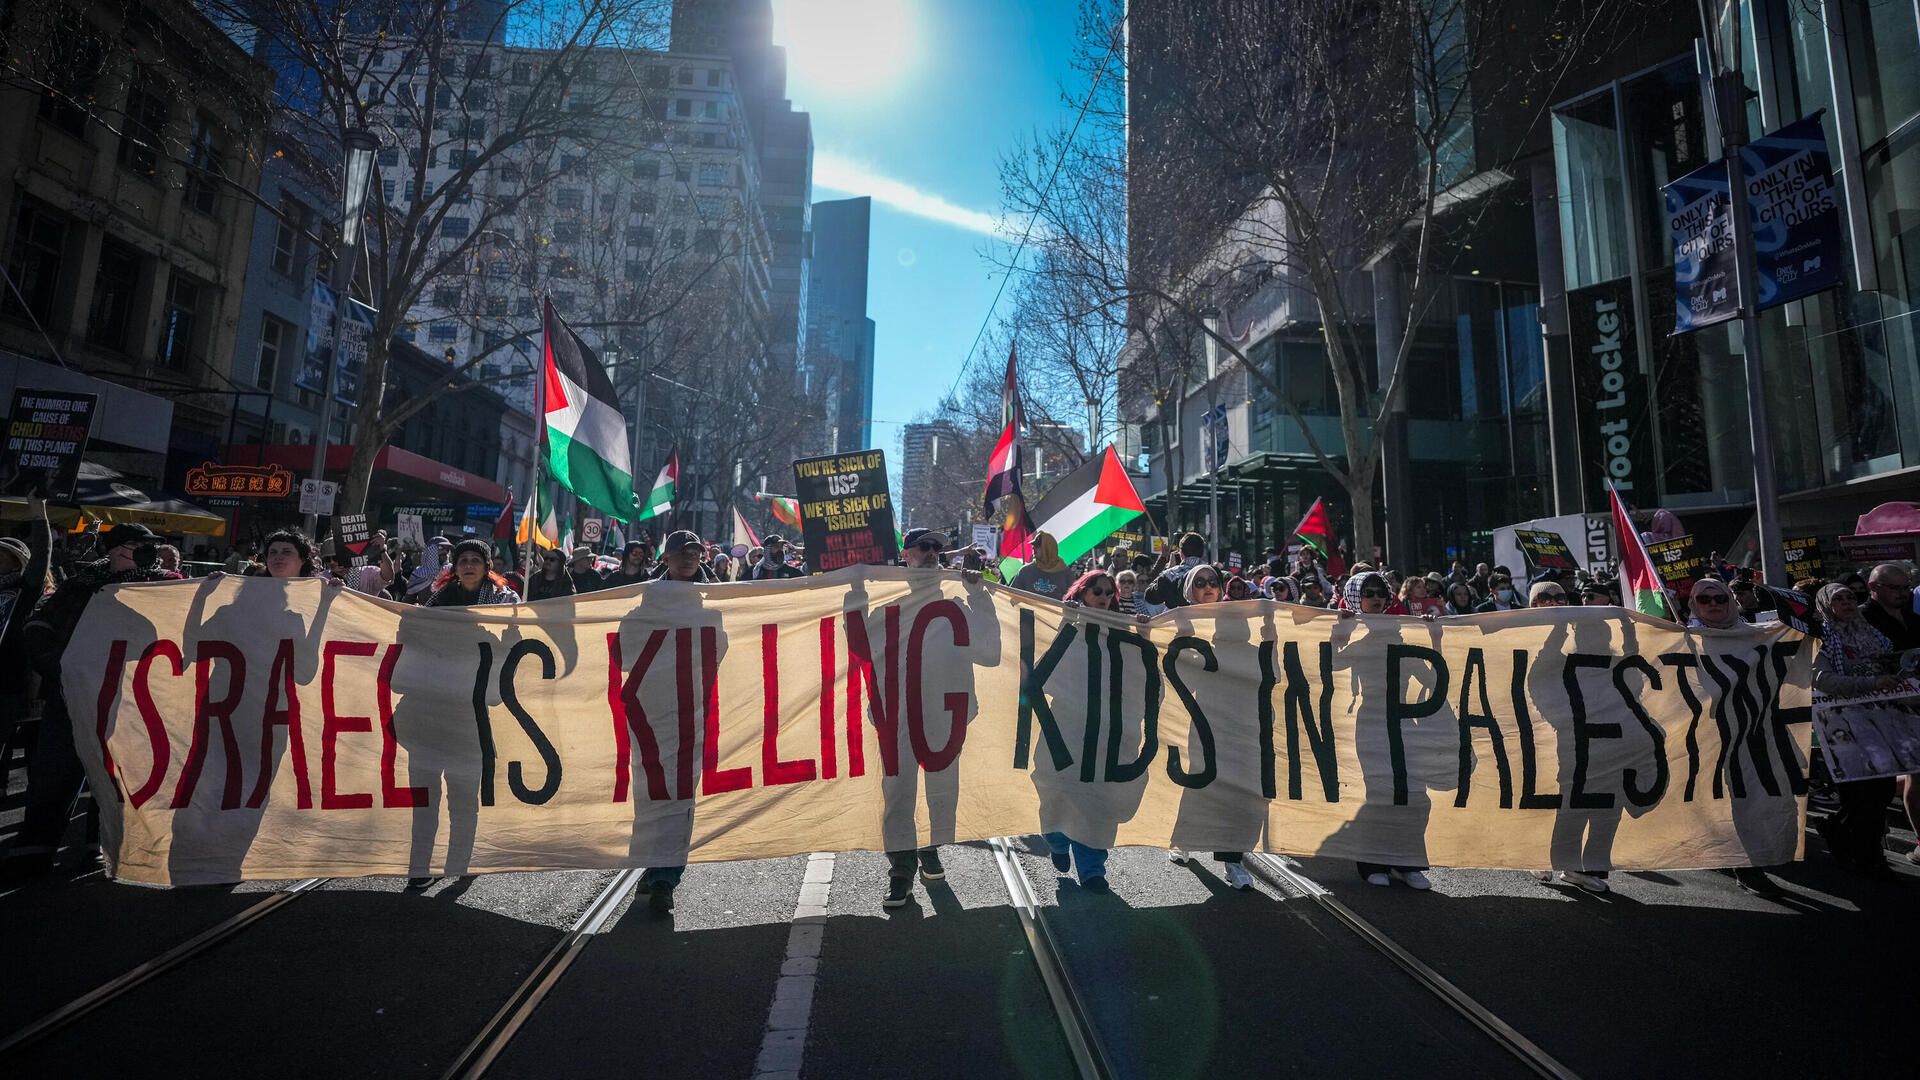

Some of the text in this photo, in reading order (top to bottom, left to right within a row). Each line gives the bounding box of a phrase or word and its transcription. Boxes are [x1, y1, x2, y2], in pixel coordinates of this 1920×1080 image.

[1749, 153, 1816, 196] ONLY IN
[1765, 175, 1805, 204] THIS
[1671, 193, 1721, 231] ONLY IN
[1760, 182, 1825, 223] CITY OF
[1785, 196, 1833, 227] OURS
[1685, 214, 1713, 238] THIS
[1681, 219, 1728, 256] CITY OF
[1698, 232, 1733, 260] OURS
[1592, 299, 1626, 410] Locker
[20, 396, 89, 412] THE NUMBER ONE
[32, 411, 71, 425] CAUSE OF
[10, 421, 88, 440] CHILD DEATHS
[9, 438, 78, 454] ON THIS PLANET
[20, 453, 60, 468] IS ISRAEL
[796, 453, 881, 478] YOU'RE SICK OF
[828, 473, 860, 496] US?
[392, 506, 456, 516] FIRSTFROST
[803, 493, 887, 519] WE'RE SICK OF
[340, 514, 366, 525] DEATH
[341, 523, 368, 534] DEATH
[586, 526, 599, 534] 30
[342, 531, 370, 543] TO THE
[826, 529, 874, 552] KILLING
[1791, 539, 1808, 549] SICK
[1808, 537, 1817, 548] OF
[351, 555, 369, 567] IDF
[820, 546, 885, 570] CHILDREN!
[1663, 548, 1683, 562] US?
[1785, 548, 1805, 562] US?
[1795, 560, 1813, 571] SICK
[1813, 559, 1823, 569] OF
[96, 599, 1813, 811] ISRAEL IS KILLING KIDS IN PALESTINE
